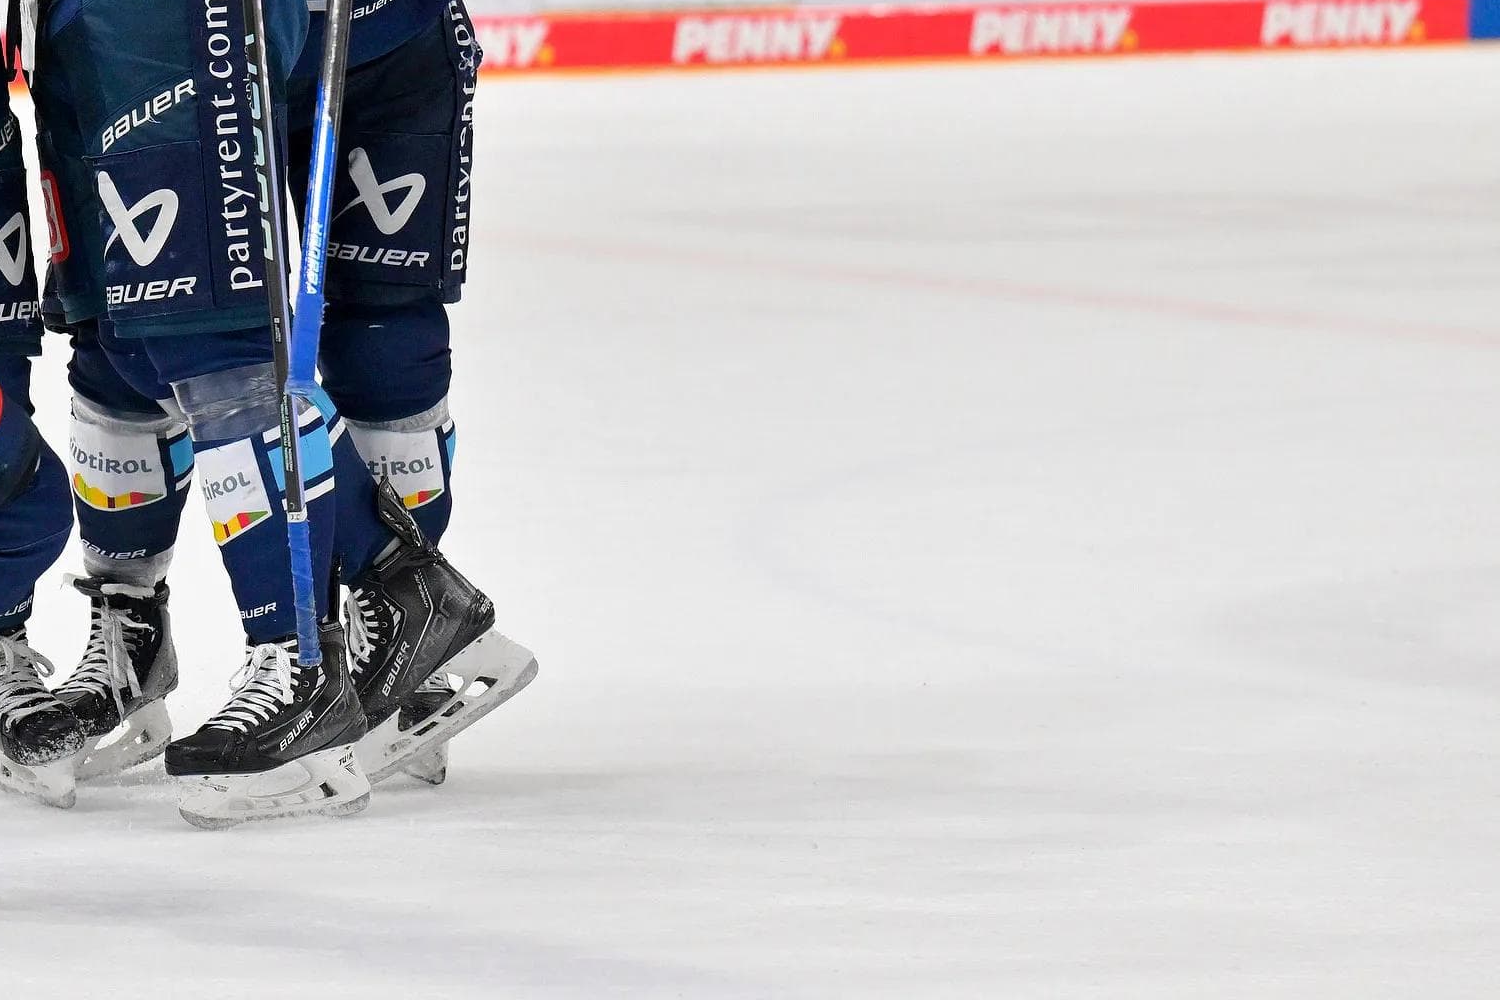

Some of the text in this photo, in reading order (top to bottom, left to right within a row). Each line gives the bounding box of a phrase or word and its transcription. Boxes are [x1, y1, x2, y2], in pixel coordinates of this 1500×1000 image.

[101, 77, 199, 155] BAUER
[381, 640, 411, 697] BAUER
[279, 710, 316, 752] BAUER
